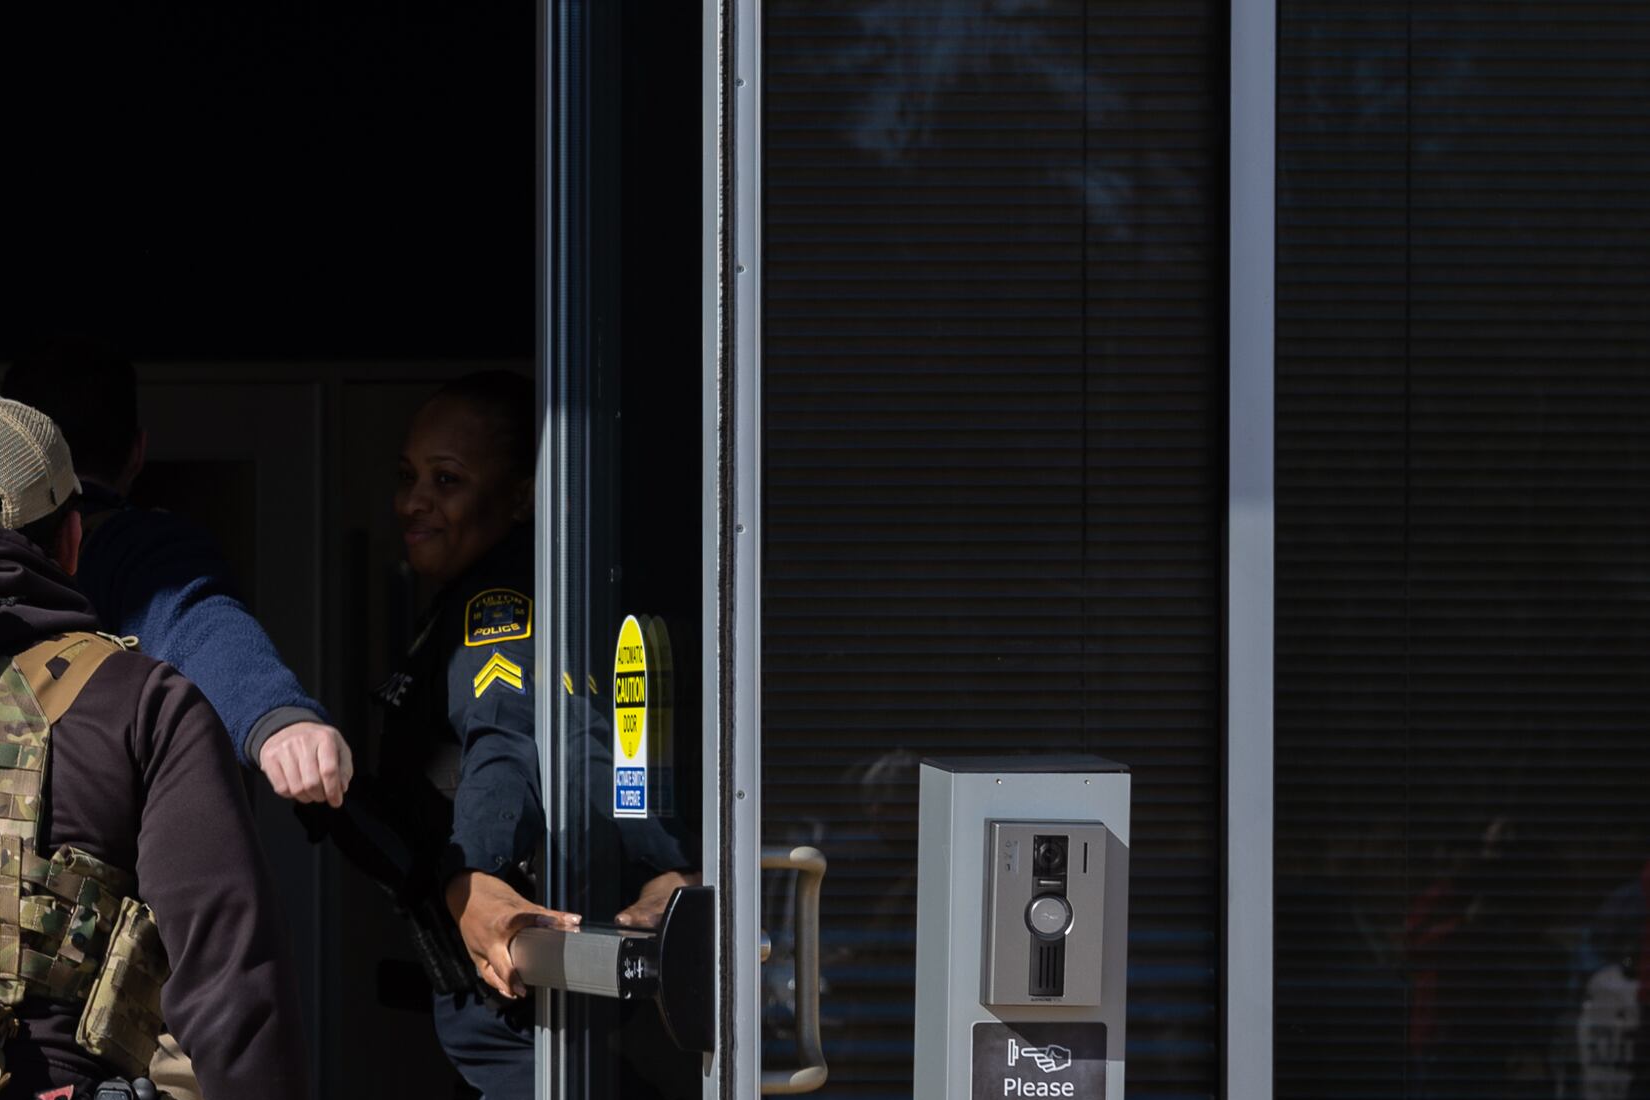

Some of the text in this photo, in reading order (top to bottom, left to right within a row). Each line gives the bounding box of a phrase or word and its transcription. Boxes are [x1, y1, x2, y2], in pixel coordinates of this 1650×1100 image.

[473, 622, 522, 637] POLICE
[618, 645, 643, 665] AUTOMATIC
[615, 677, 645, 704] CAUTION
[622, 714, 638, 734] DOOR
[1003, 1077, 1075, 1097] Please
